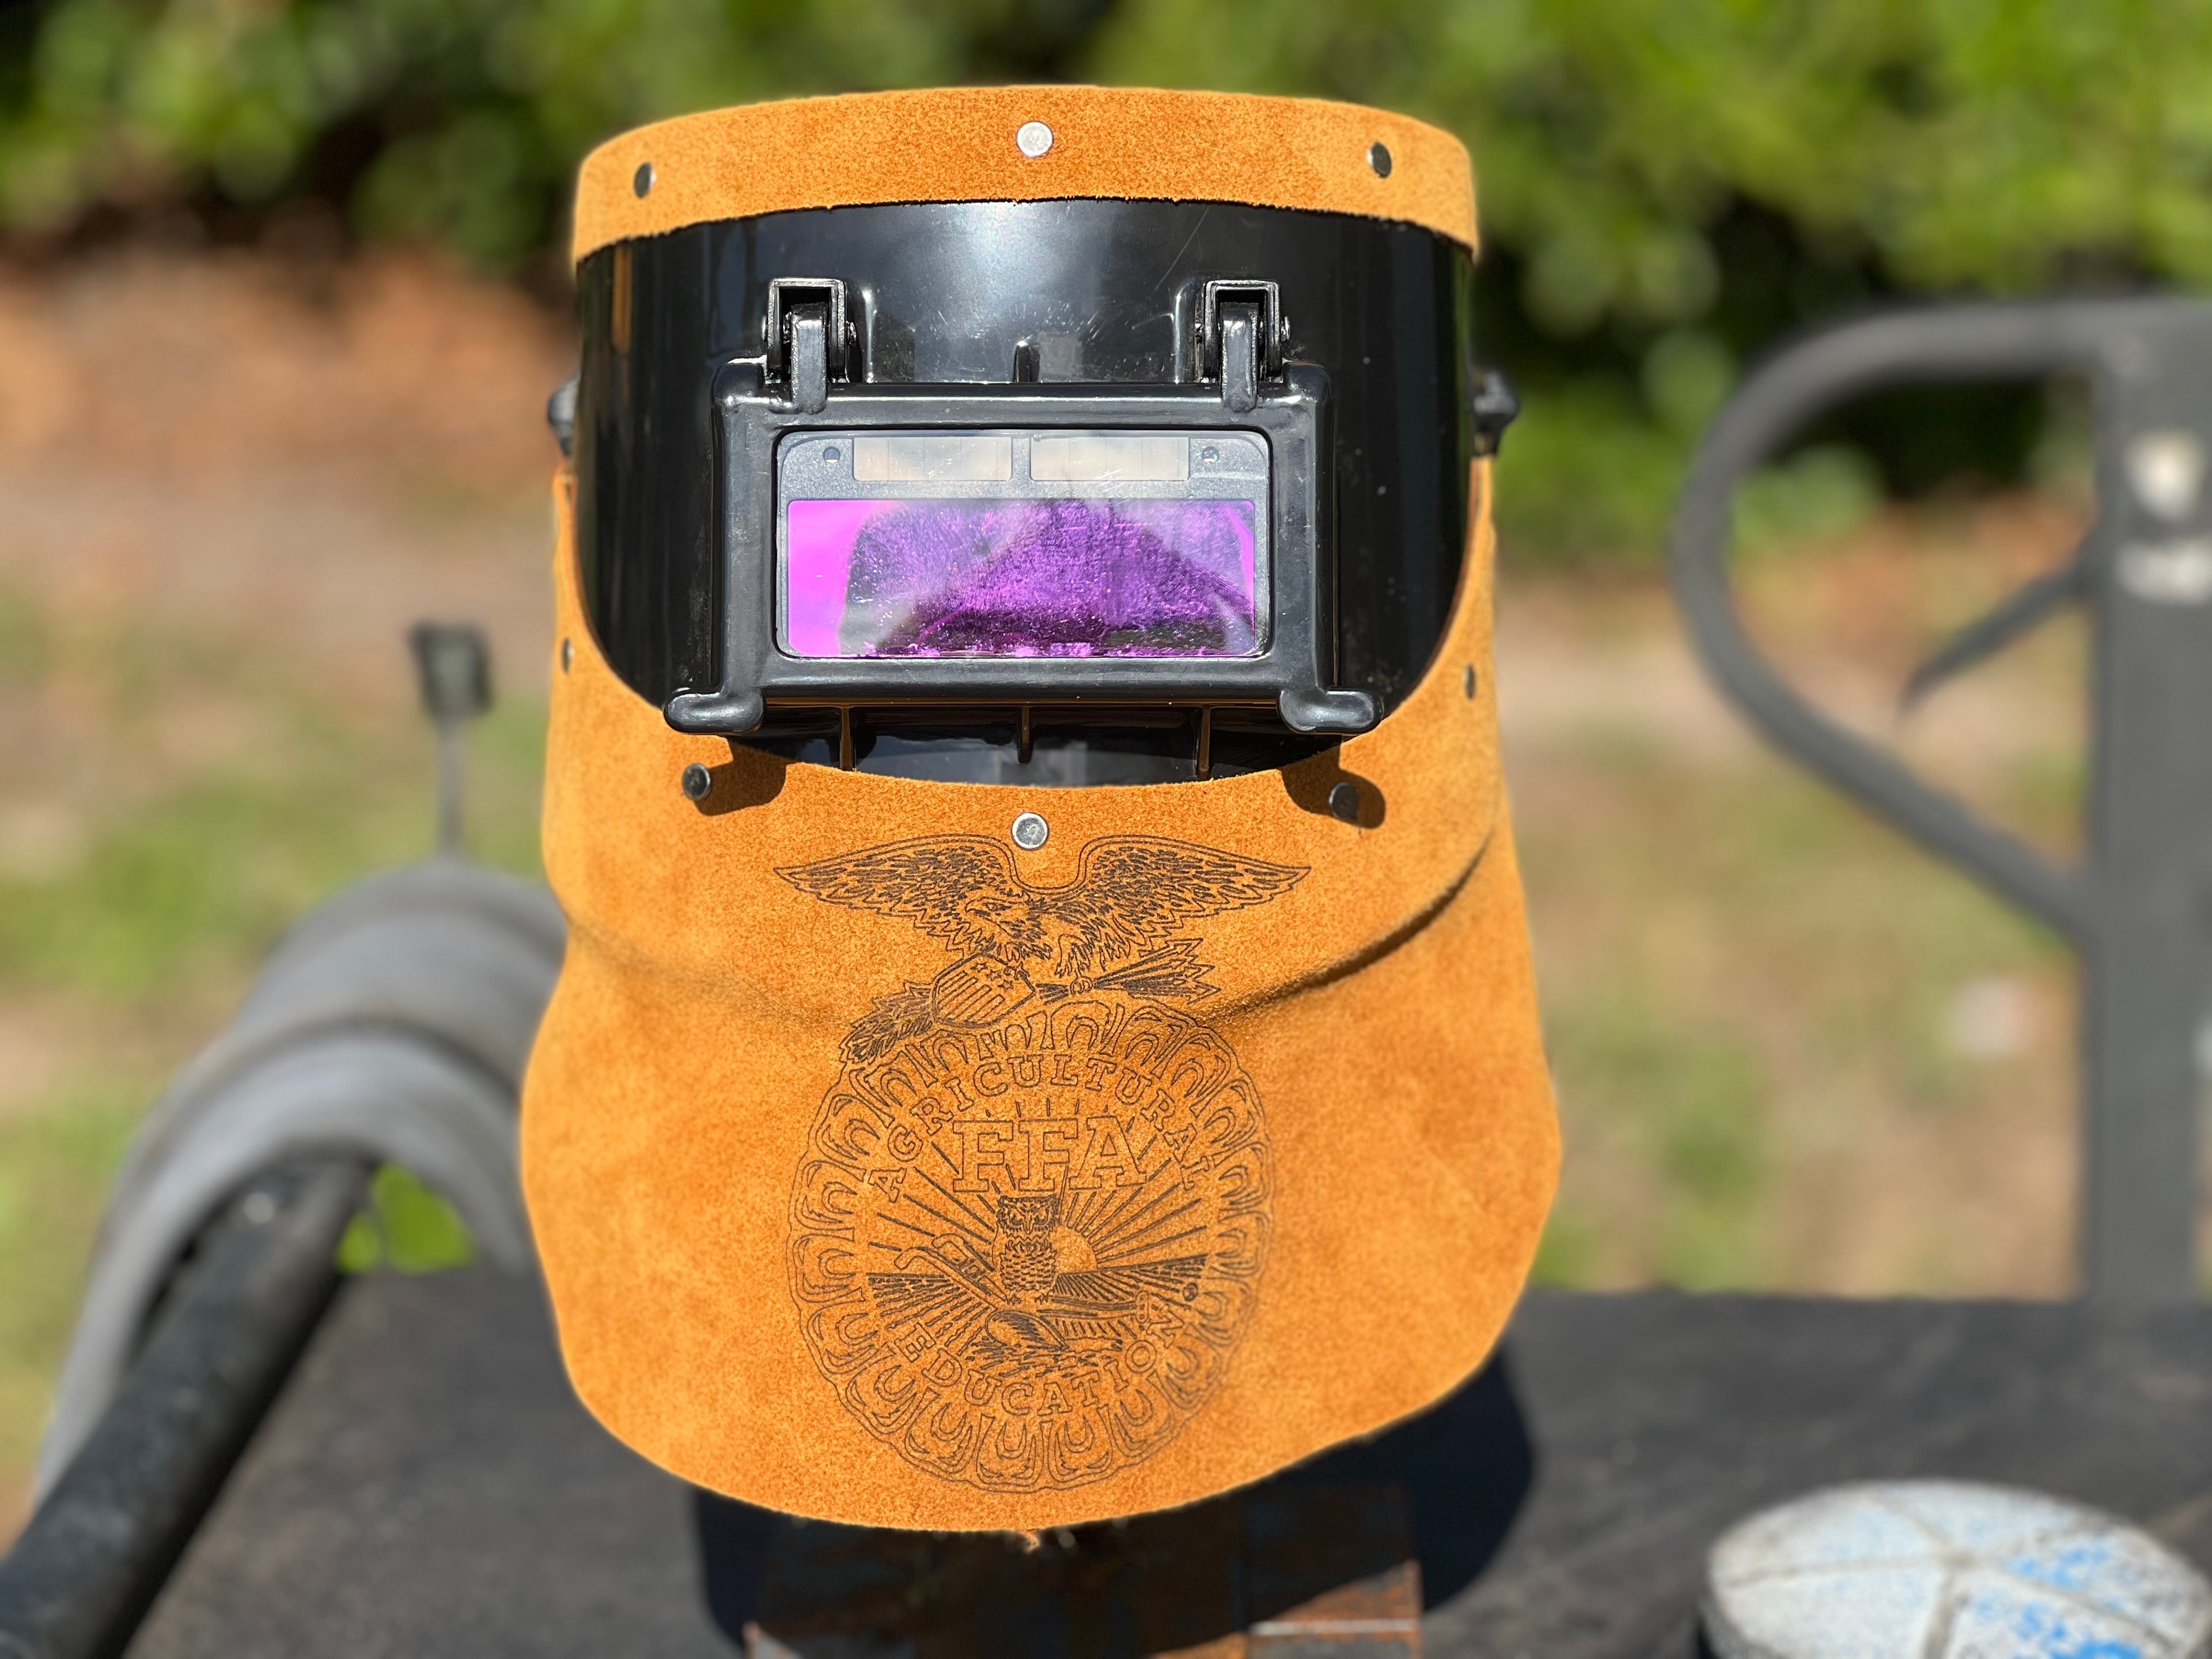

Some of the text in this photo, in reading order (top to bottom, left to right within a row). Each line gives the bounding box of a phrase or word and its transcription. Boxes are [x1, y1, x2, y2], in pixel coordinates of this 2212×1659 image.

[868, 1054, 1210, 1203] AGRICULTURAL
[952, 1115, 1147, 1193] FFA
[894, 1303, 1185, 1416] EDUCATION
